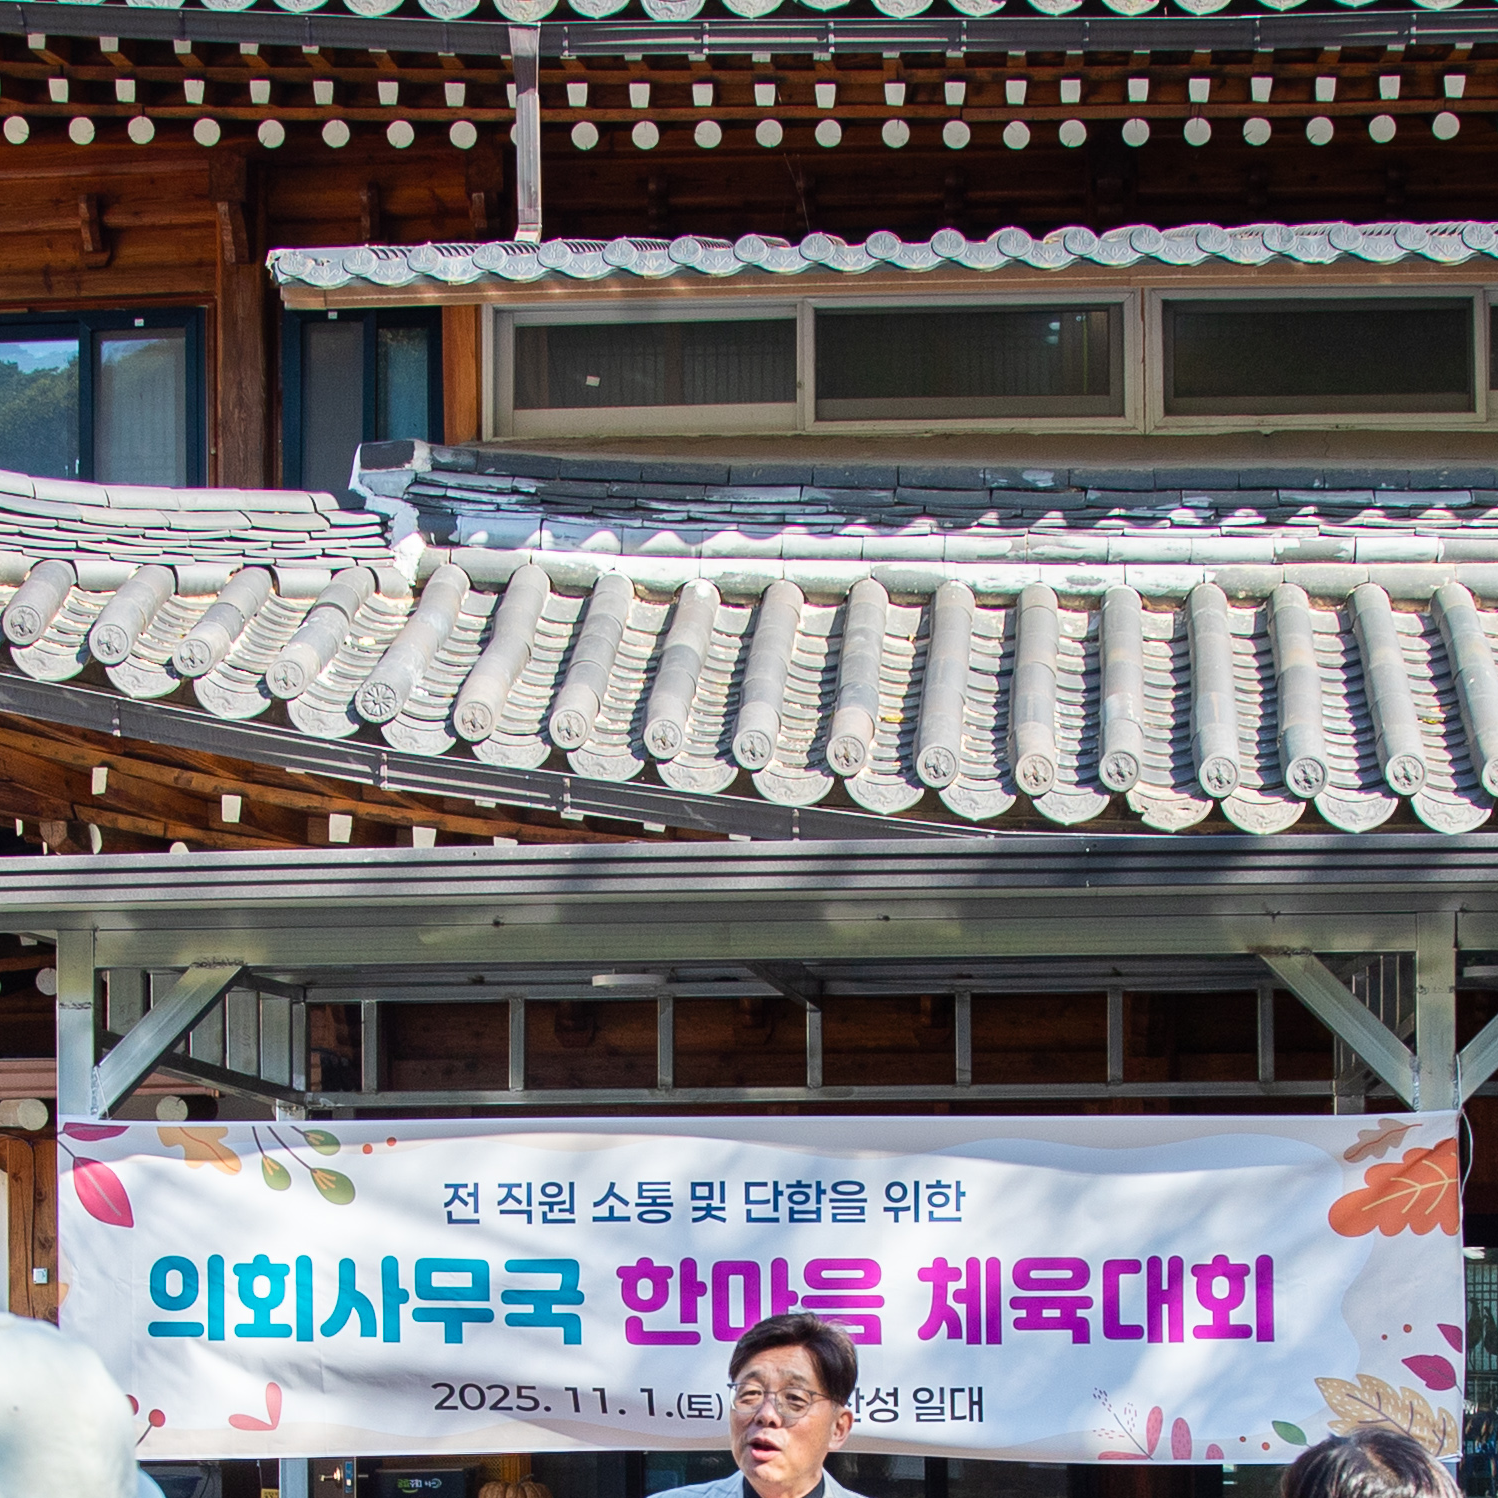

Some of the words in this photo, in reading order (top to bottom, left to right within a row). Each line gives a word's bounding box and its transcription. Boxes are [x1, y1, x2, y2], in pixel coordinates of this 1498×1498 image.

[443, 1182, 480, 1224] 전
[497, 1181, 576, 1224] 직원
[592, 1181, 674, 1224] 소통
[690, 1180, 727, 1223] 및
[744, 1180, 868, 1223] 단합을
[883, 1179, 966, 1223] 위한
[147, 1253, 585, 1345] 의회사무국
[917, 1254, 1274, 1345] 체육대회
[430, 1382, 552, 1412] 2025.
[564, 1386, 627, 1415] 11.
[639, 1387, 723, 1421] 1.(토)
[912, 1386, 984, 1423] 일대
